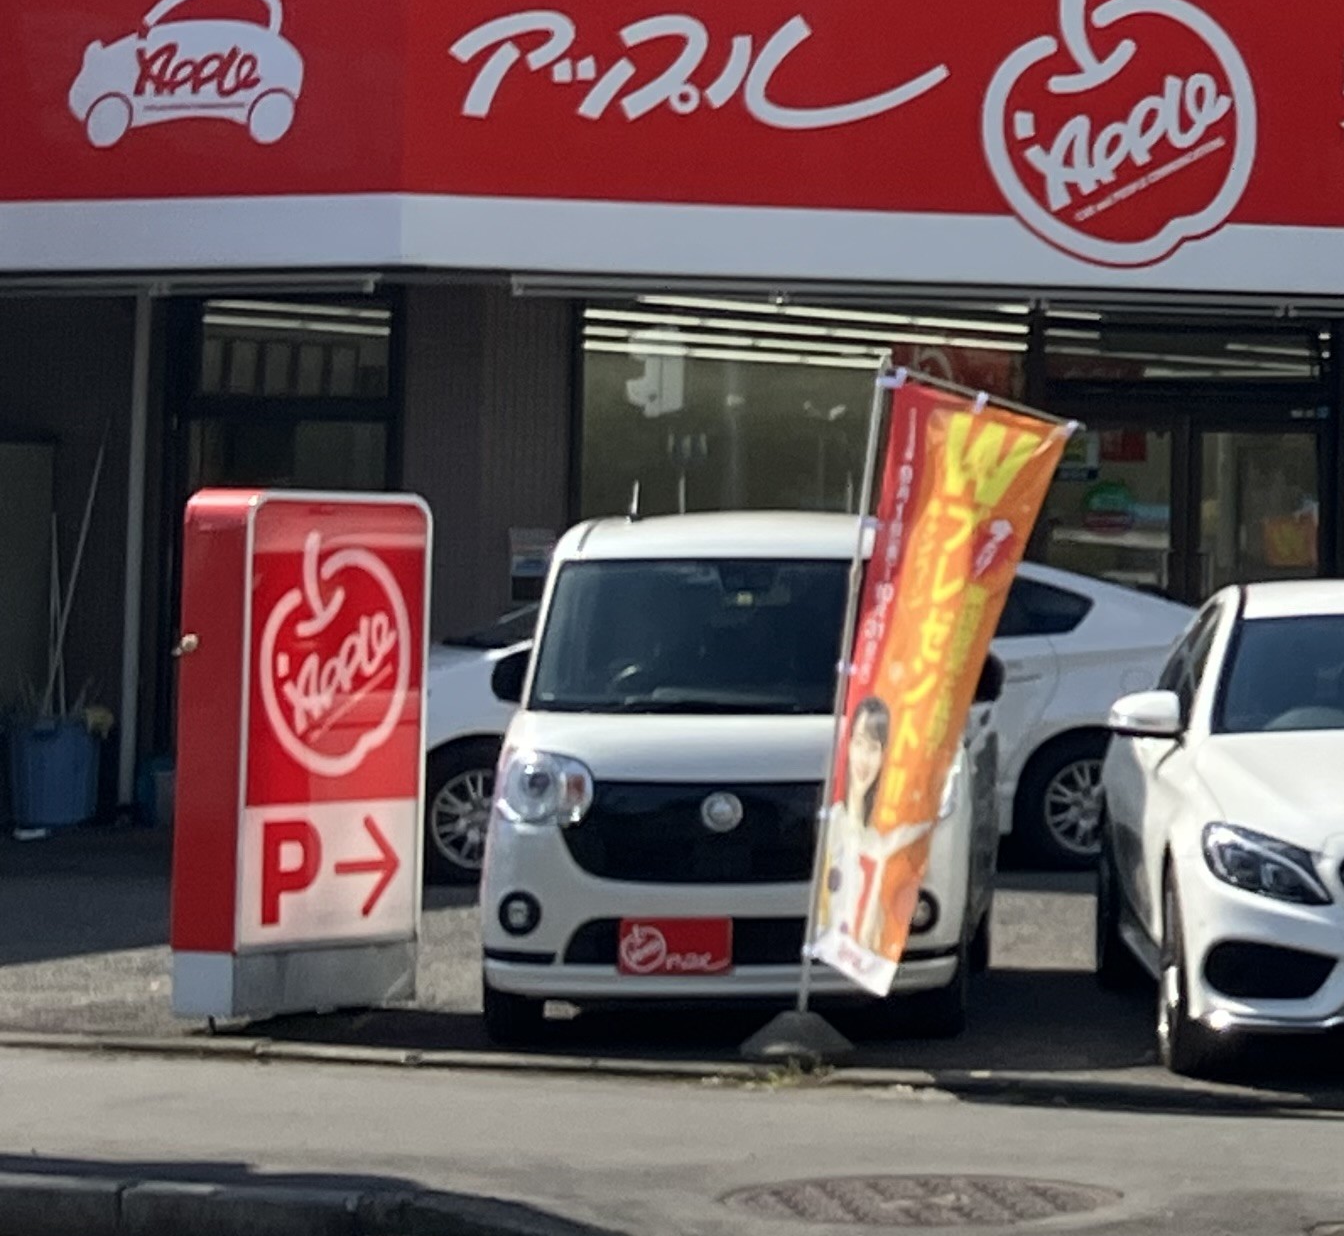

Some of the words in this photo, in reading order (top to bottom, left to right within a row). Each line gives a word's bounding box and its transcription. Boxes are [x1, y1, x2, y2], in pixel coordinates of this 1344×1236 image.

[448, 9, 950, 130] アップル
[261, 820, 323, 926] P
